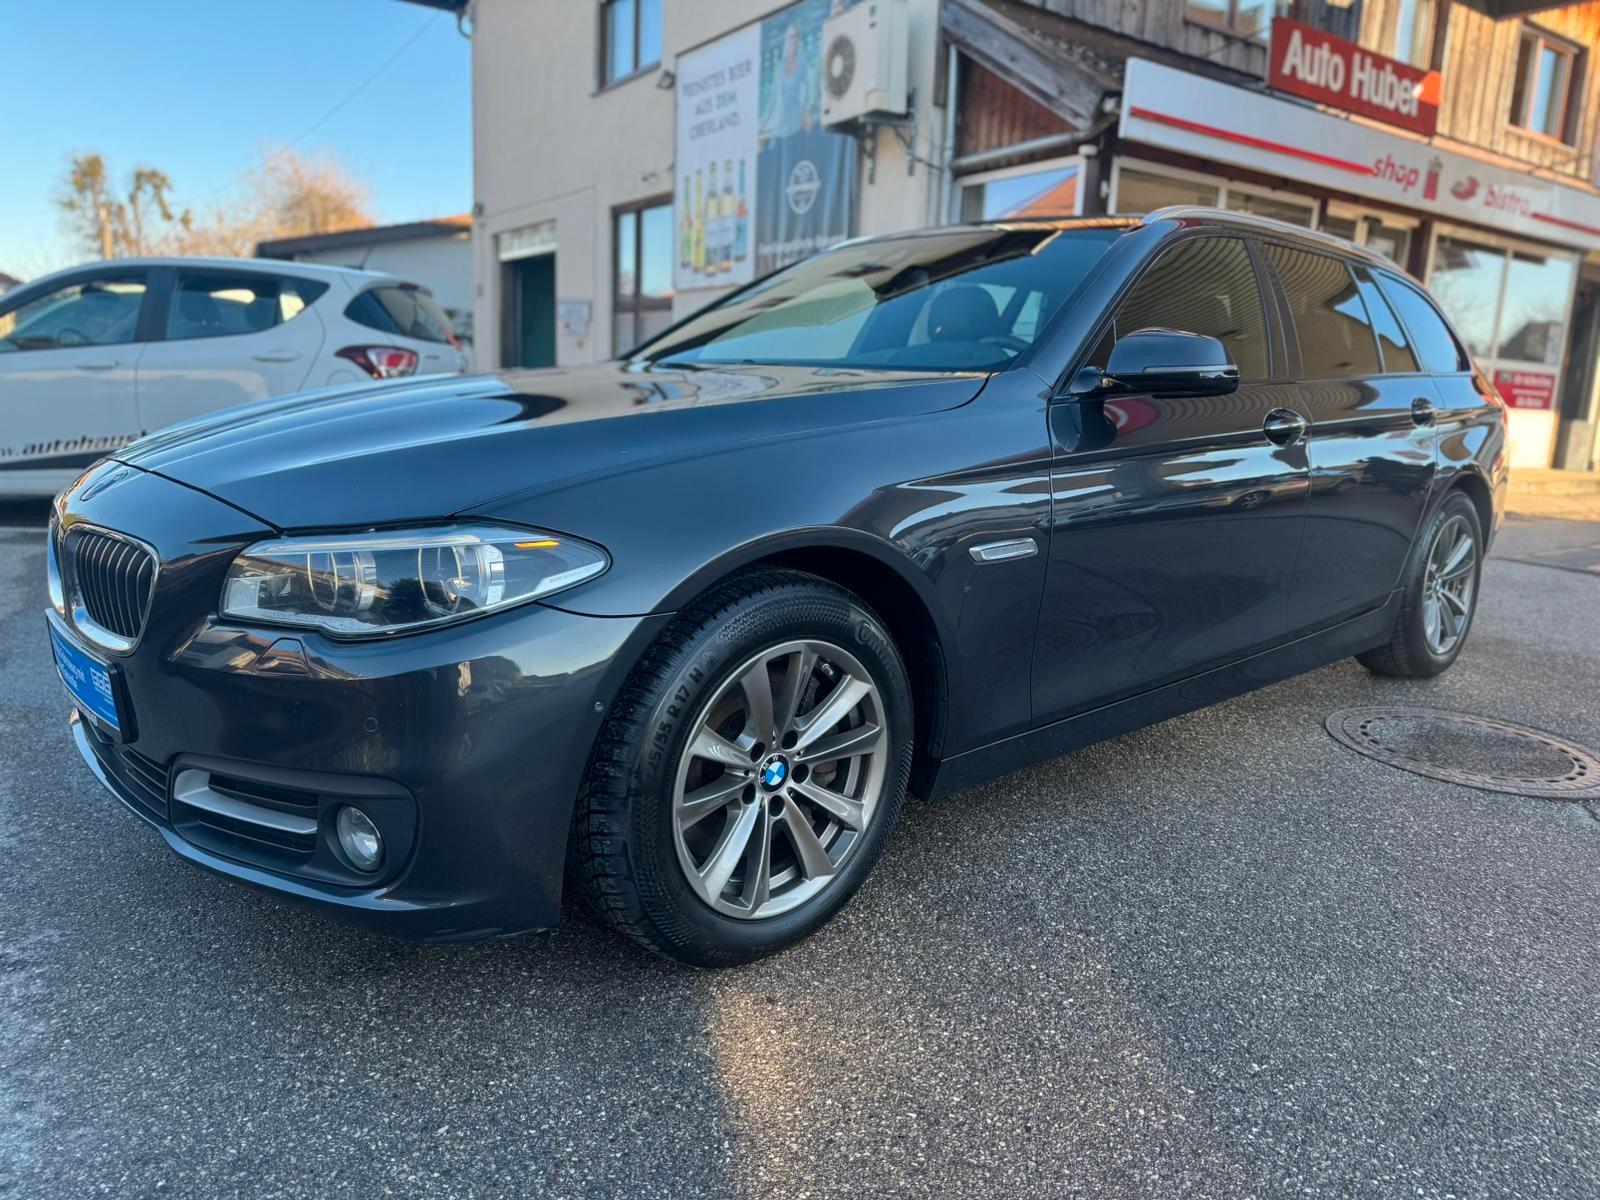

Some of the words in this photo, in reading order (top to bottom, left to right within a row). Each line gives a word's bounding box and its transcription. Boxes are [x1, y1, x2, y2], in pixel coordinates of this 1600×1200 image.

[1282, 29, 1346, 92] Auto
[1351, 53, 1422, 117] Huber
[1370, 154, 1420, 191] shop
[1483, 183, 1530, 216] bistro
